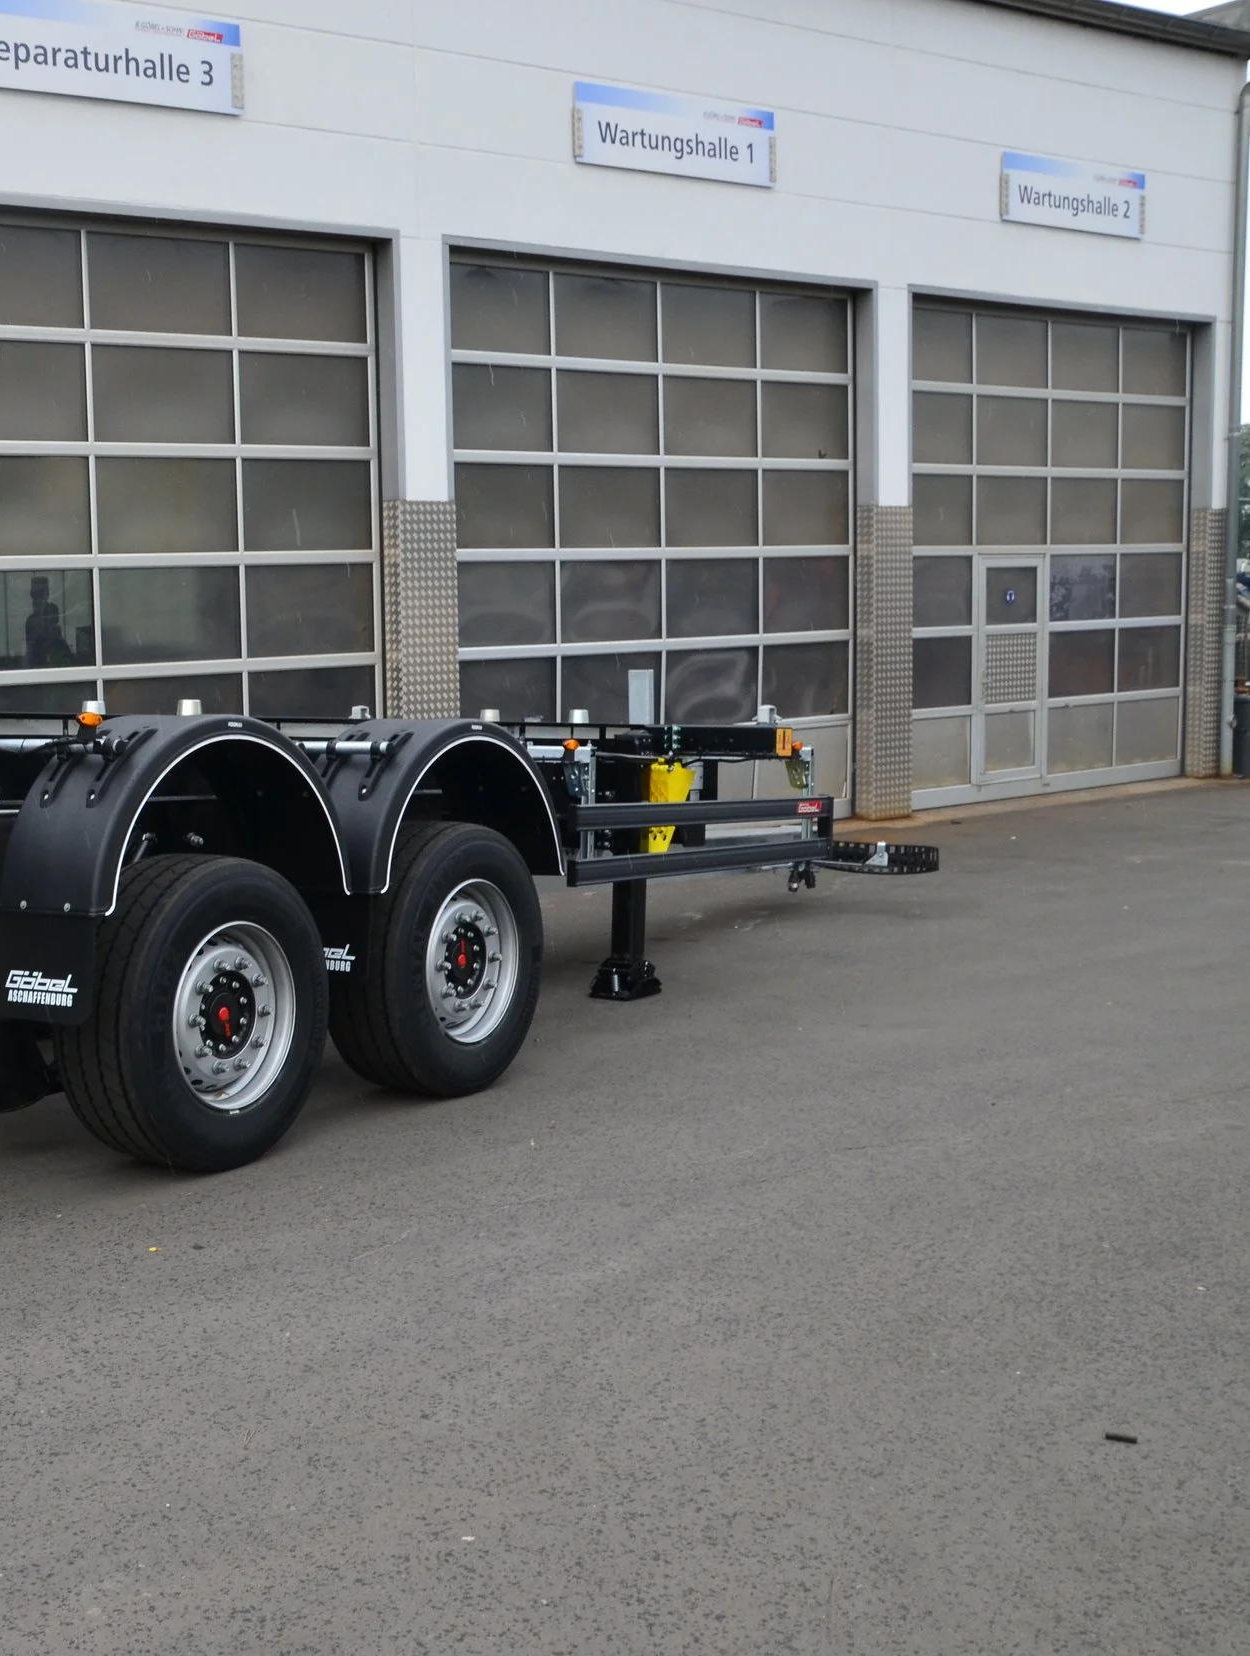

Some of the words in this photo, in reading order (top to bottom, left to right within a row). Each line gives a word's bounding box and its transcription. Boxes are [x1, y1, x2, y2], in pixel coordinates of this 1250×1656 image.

[200, 60, 214, 86] 3
[598, 120, 739, 162] Wartungshalle
[746, 143, 754, 164] 1
[1018, 184, 1119, 217] Wartungshalle
[1123, 200, 1131, 219] 2
[7, 989, 73, 1007] ASCHAFFENBURG
